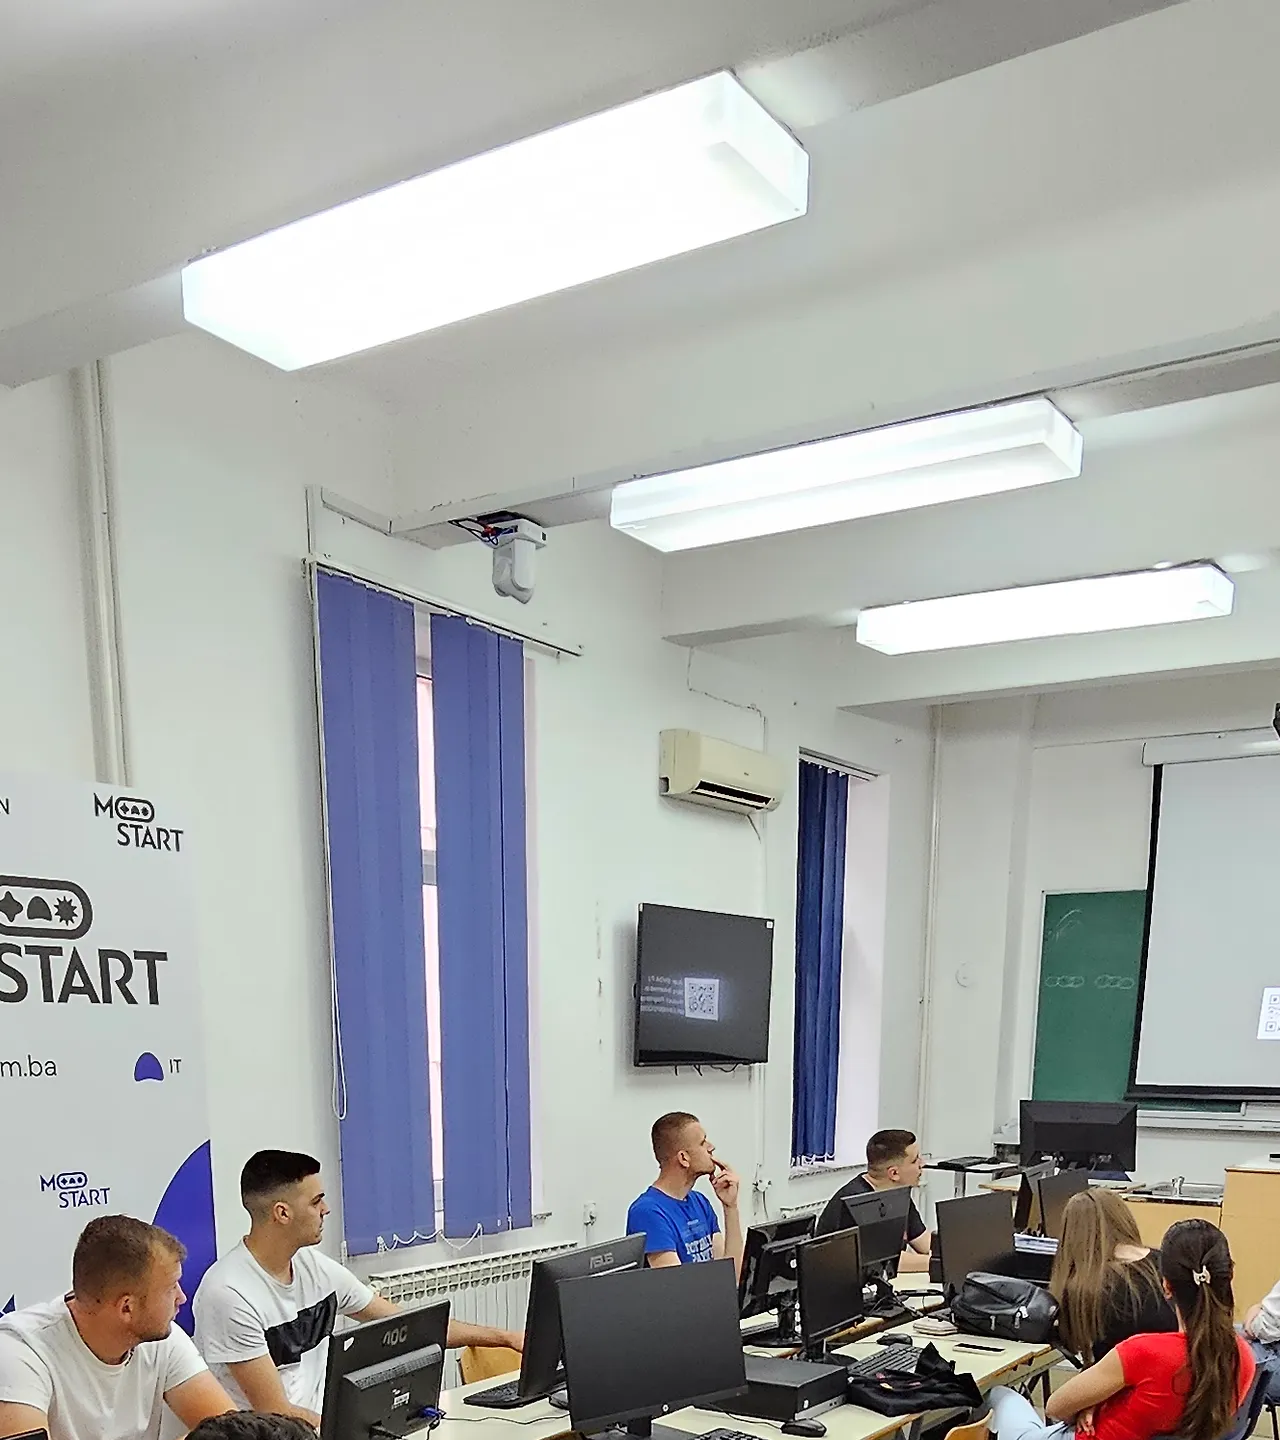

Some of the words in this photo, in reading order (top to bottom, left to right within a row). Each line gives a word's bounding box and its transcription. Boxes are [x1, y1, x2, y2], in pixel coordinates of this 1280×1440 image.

[117, 823, 184, 852] START
[168, 1058, 182, 1074] IT
[58, 1188, 110, 1209] START
[382, 1325, 408, 1346] AOC
